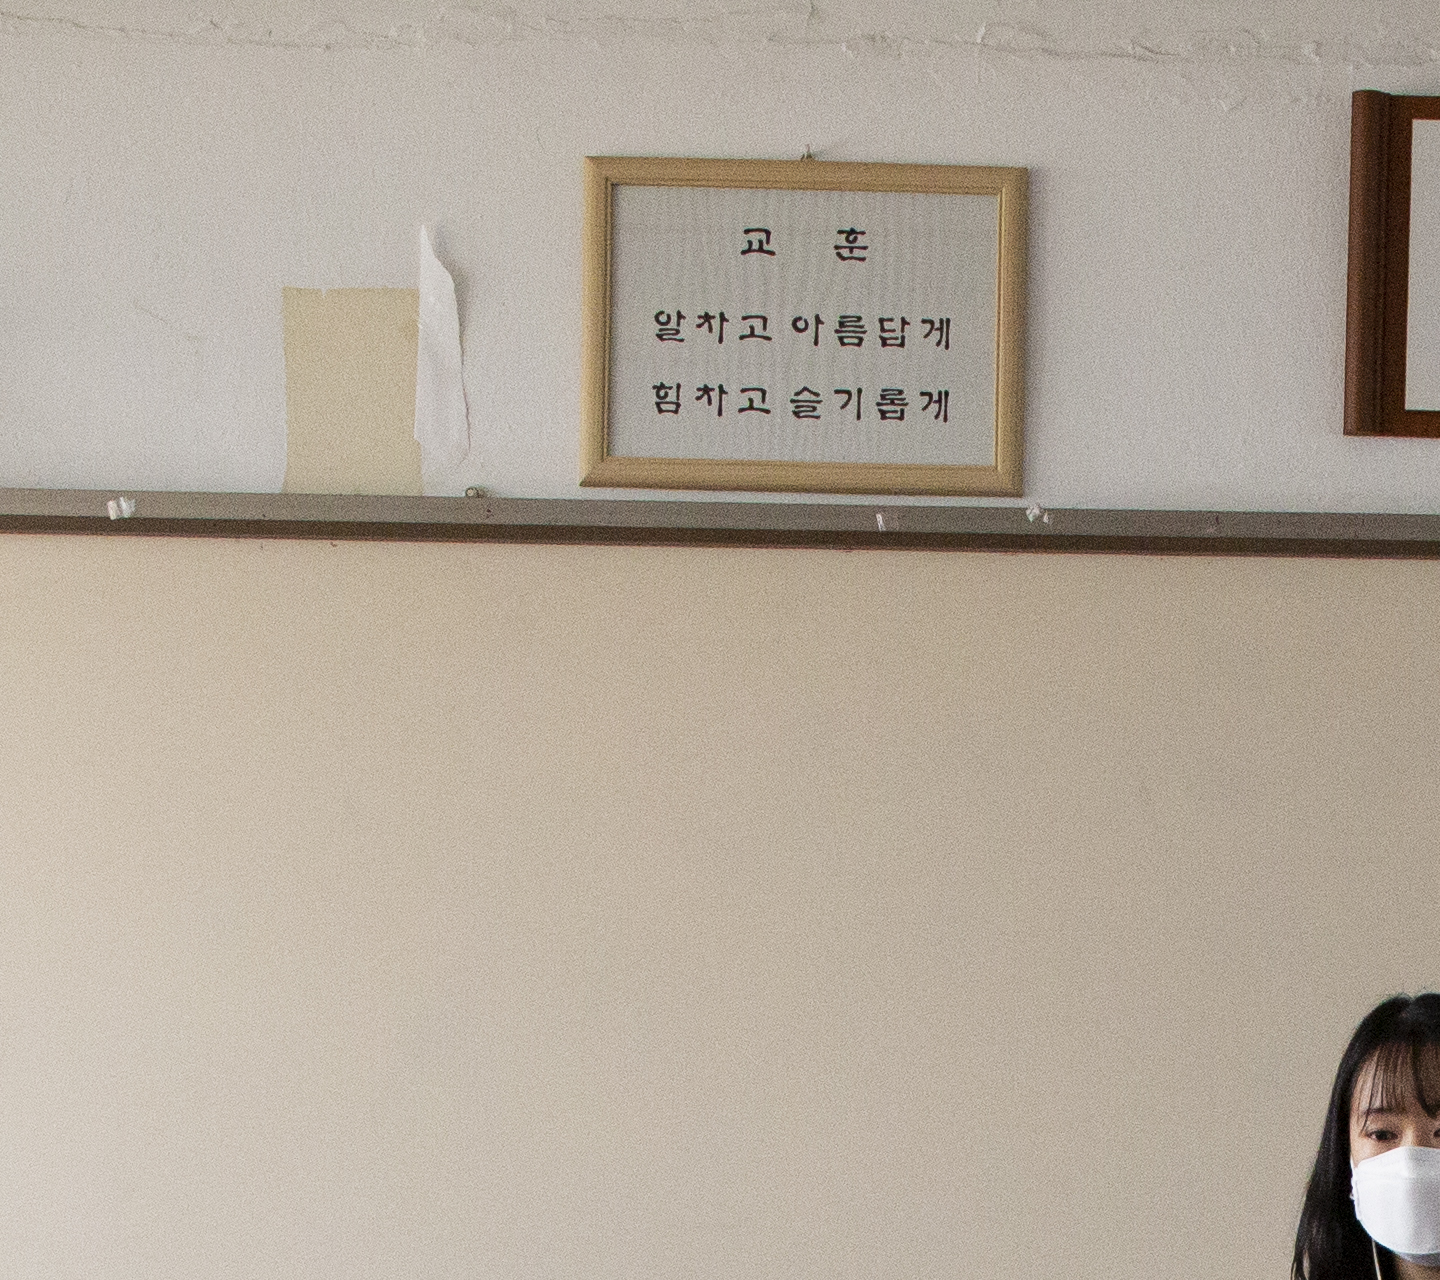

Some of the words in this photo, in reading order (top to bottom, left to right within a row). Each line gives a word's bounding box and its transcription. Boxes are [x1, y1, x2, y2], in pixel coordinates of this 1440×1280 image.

[654, 309, 774, 345] 알차고
[791, 313, 952, 350] 아름답게
[652, 382, 773, 417] 힘차고
[789, 386, 951, 423] 슬기롭게
